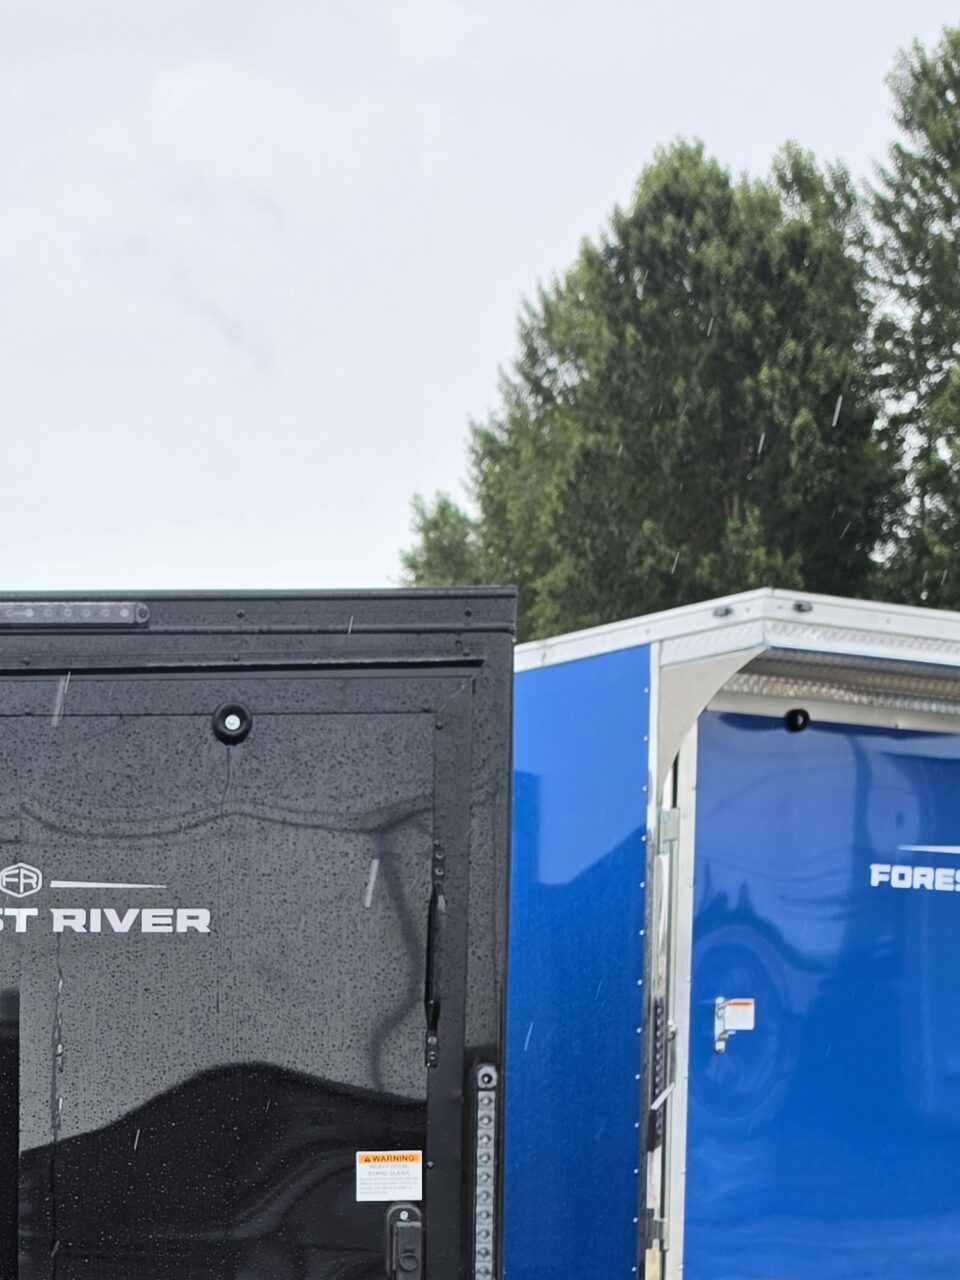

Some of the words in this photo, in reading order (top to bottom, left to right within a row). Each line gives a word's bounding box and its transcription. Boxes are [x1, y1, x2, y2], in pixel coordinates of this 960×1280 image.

[869, 863, 960, 892] FORE
[49, 907, 211, 933] RIVER
[372, 1154, 415, 1162] WARNING
